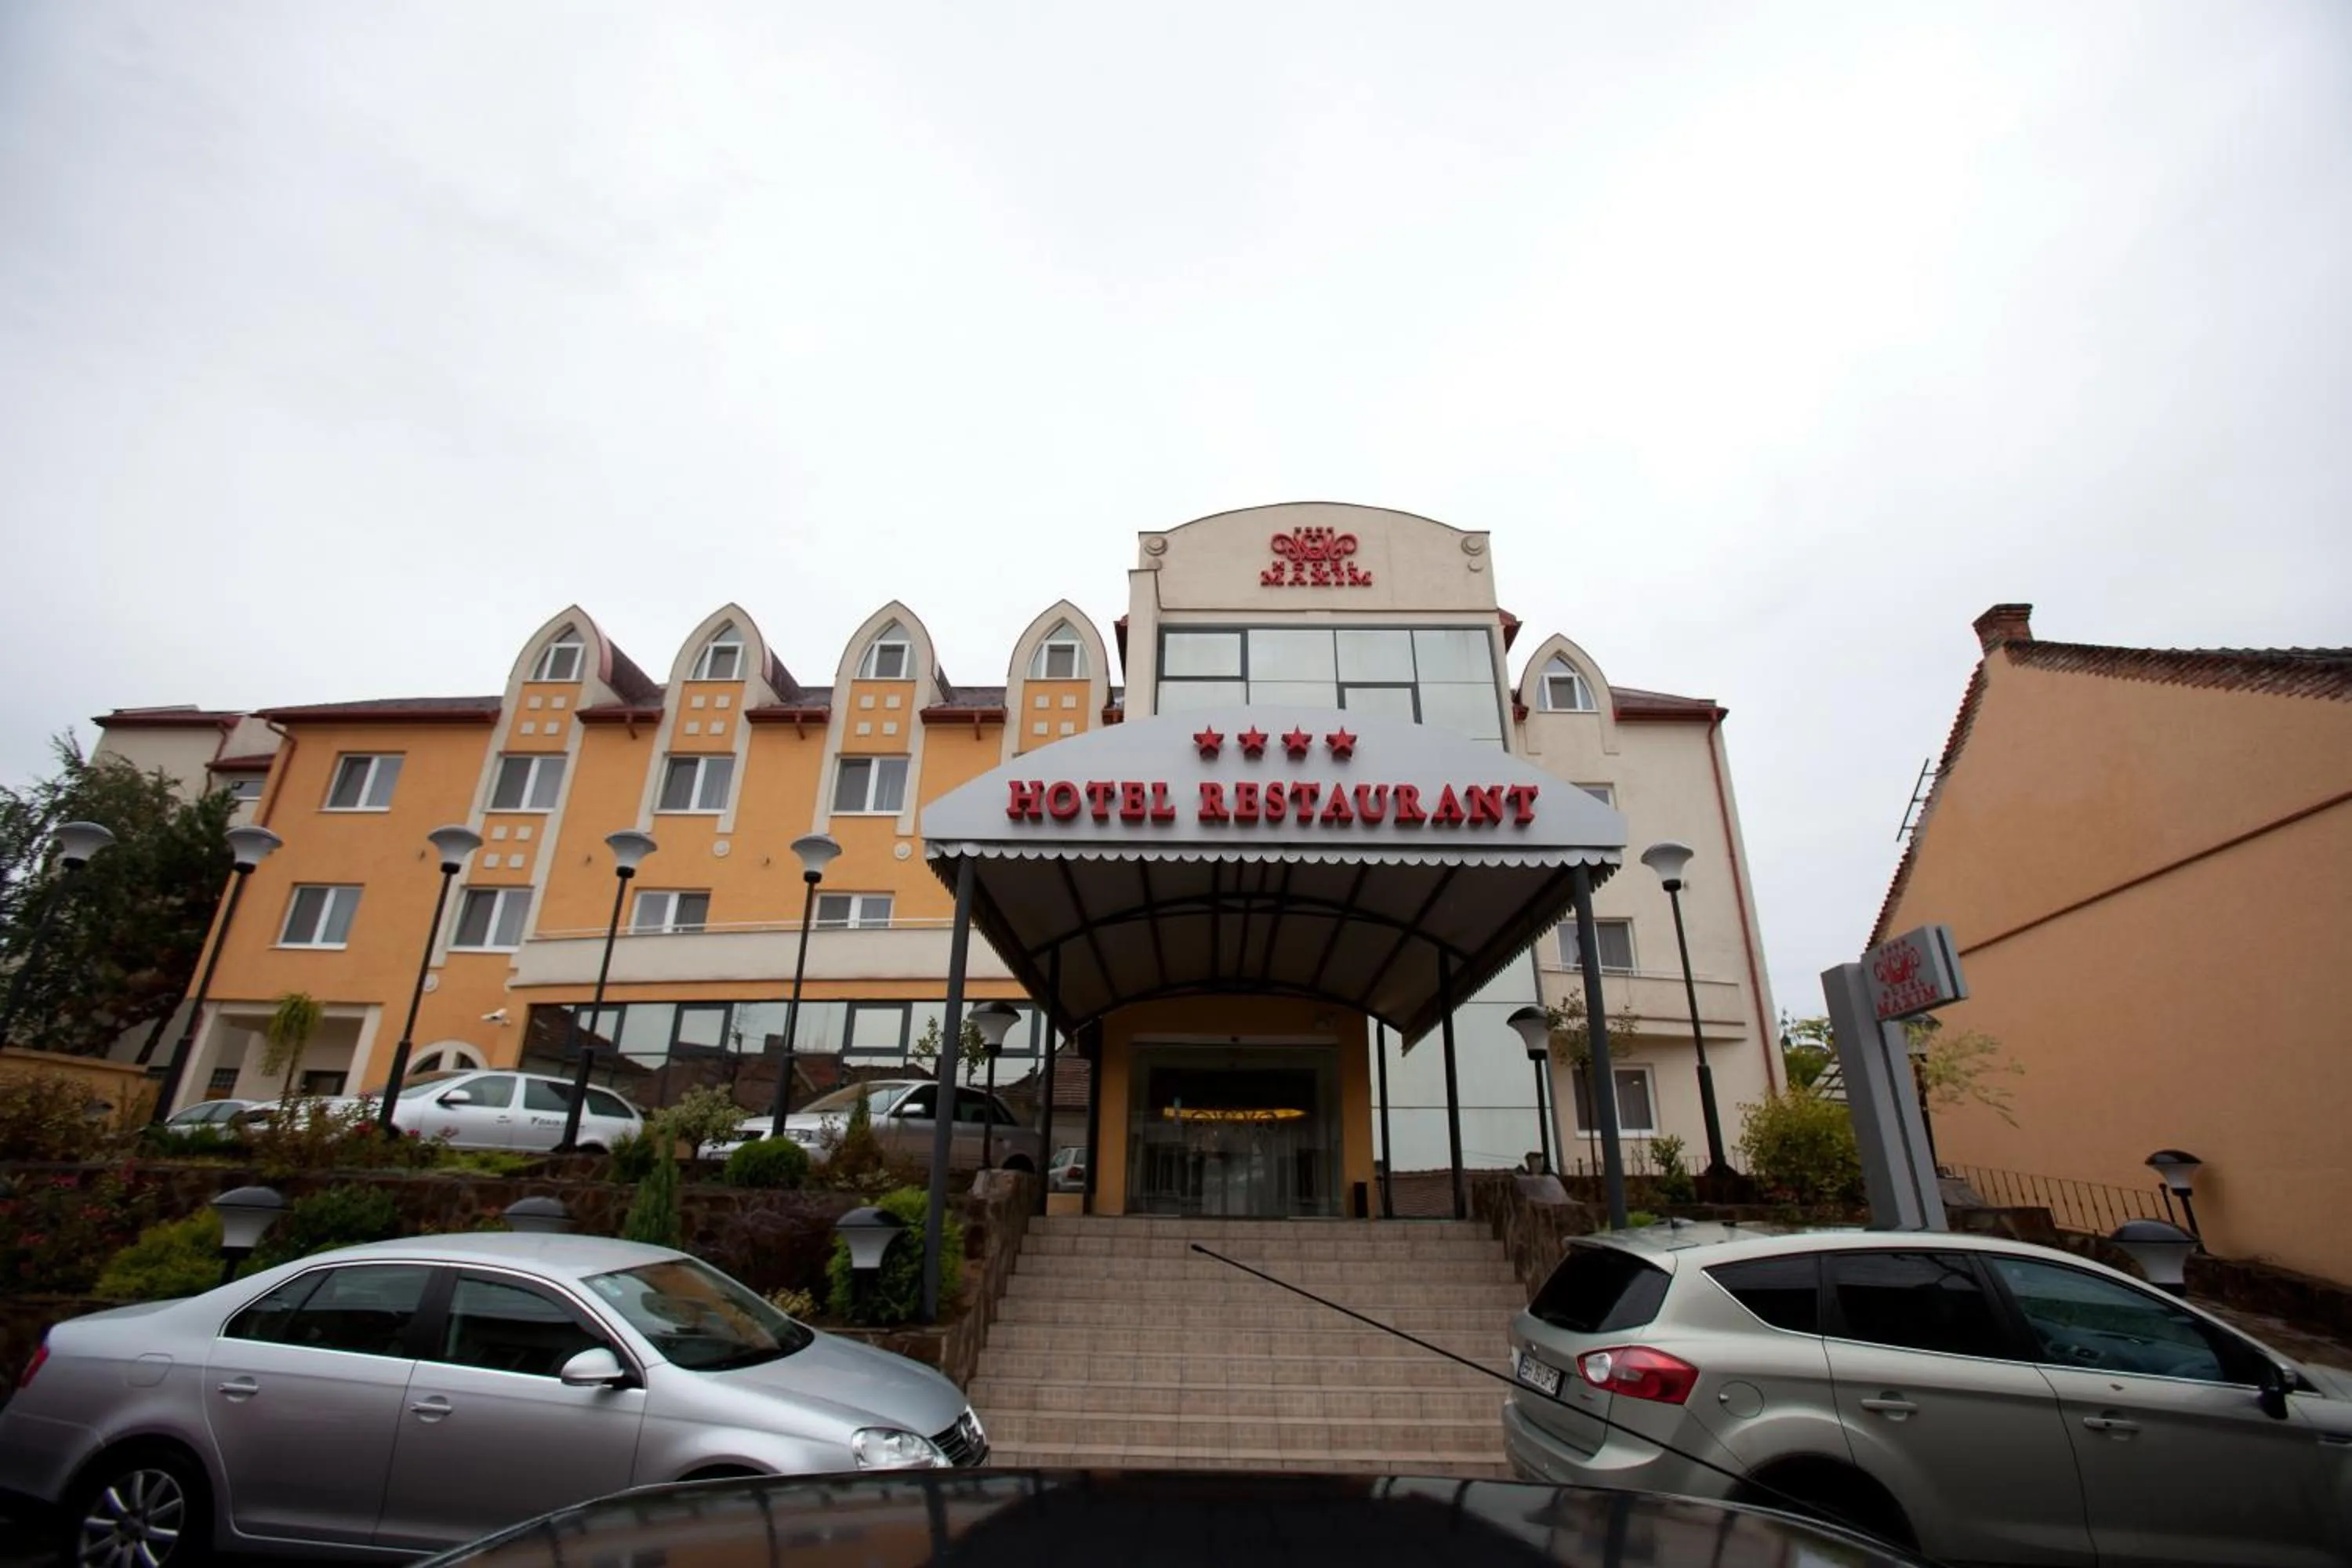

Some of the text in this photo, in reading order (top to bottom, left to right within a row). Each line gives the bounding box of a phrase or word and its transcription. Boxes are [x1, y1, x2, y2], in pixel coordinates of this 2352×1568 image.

[1259, 570, 1372, 586] MAXIM
[1007, 781, 1539, 825] HOTEL RESTAURANT
